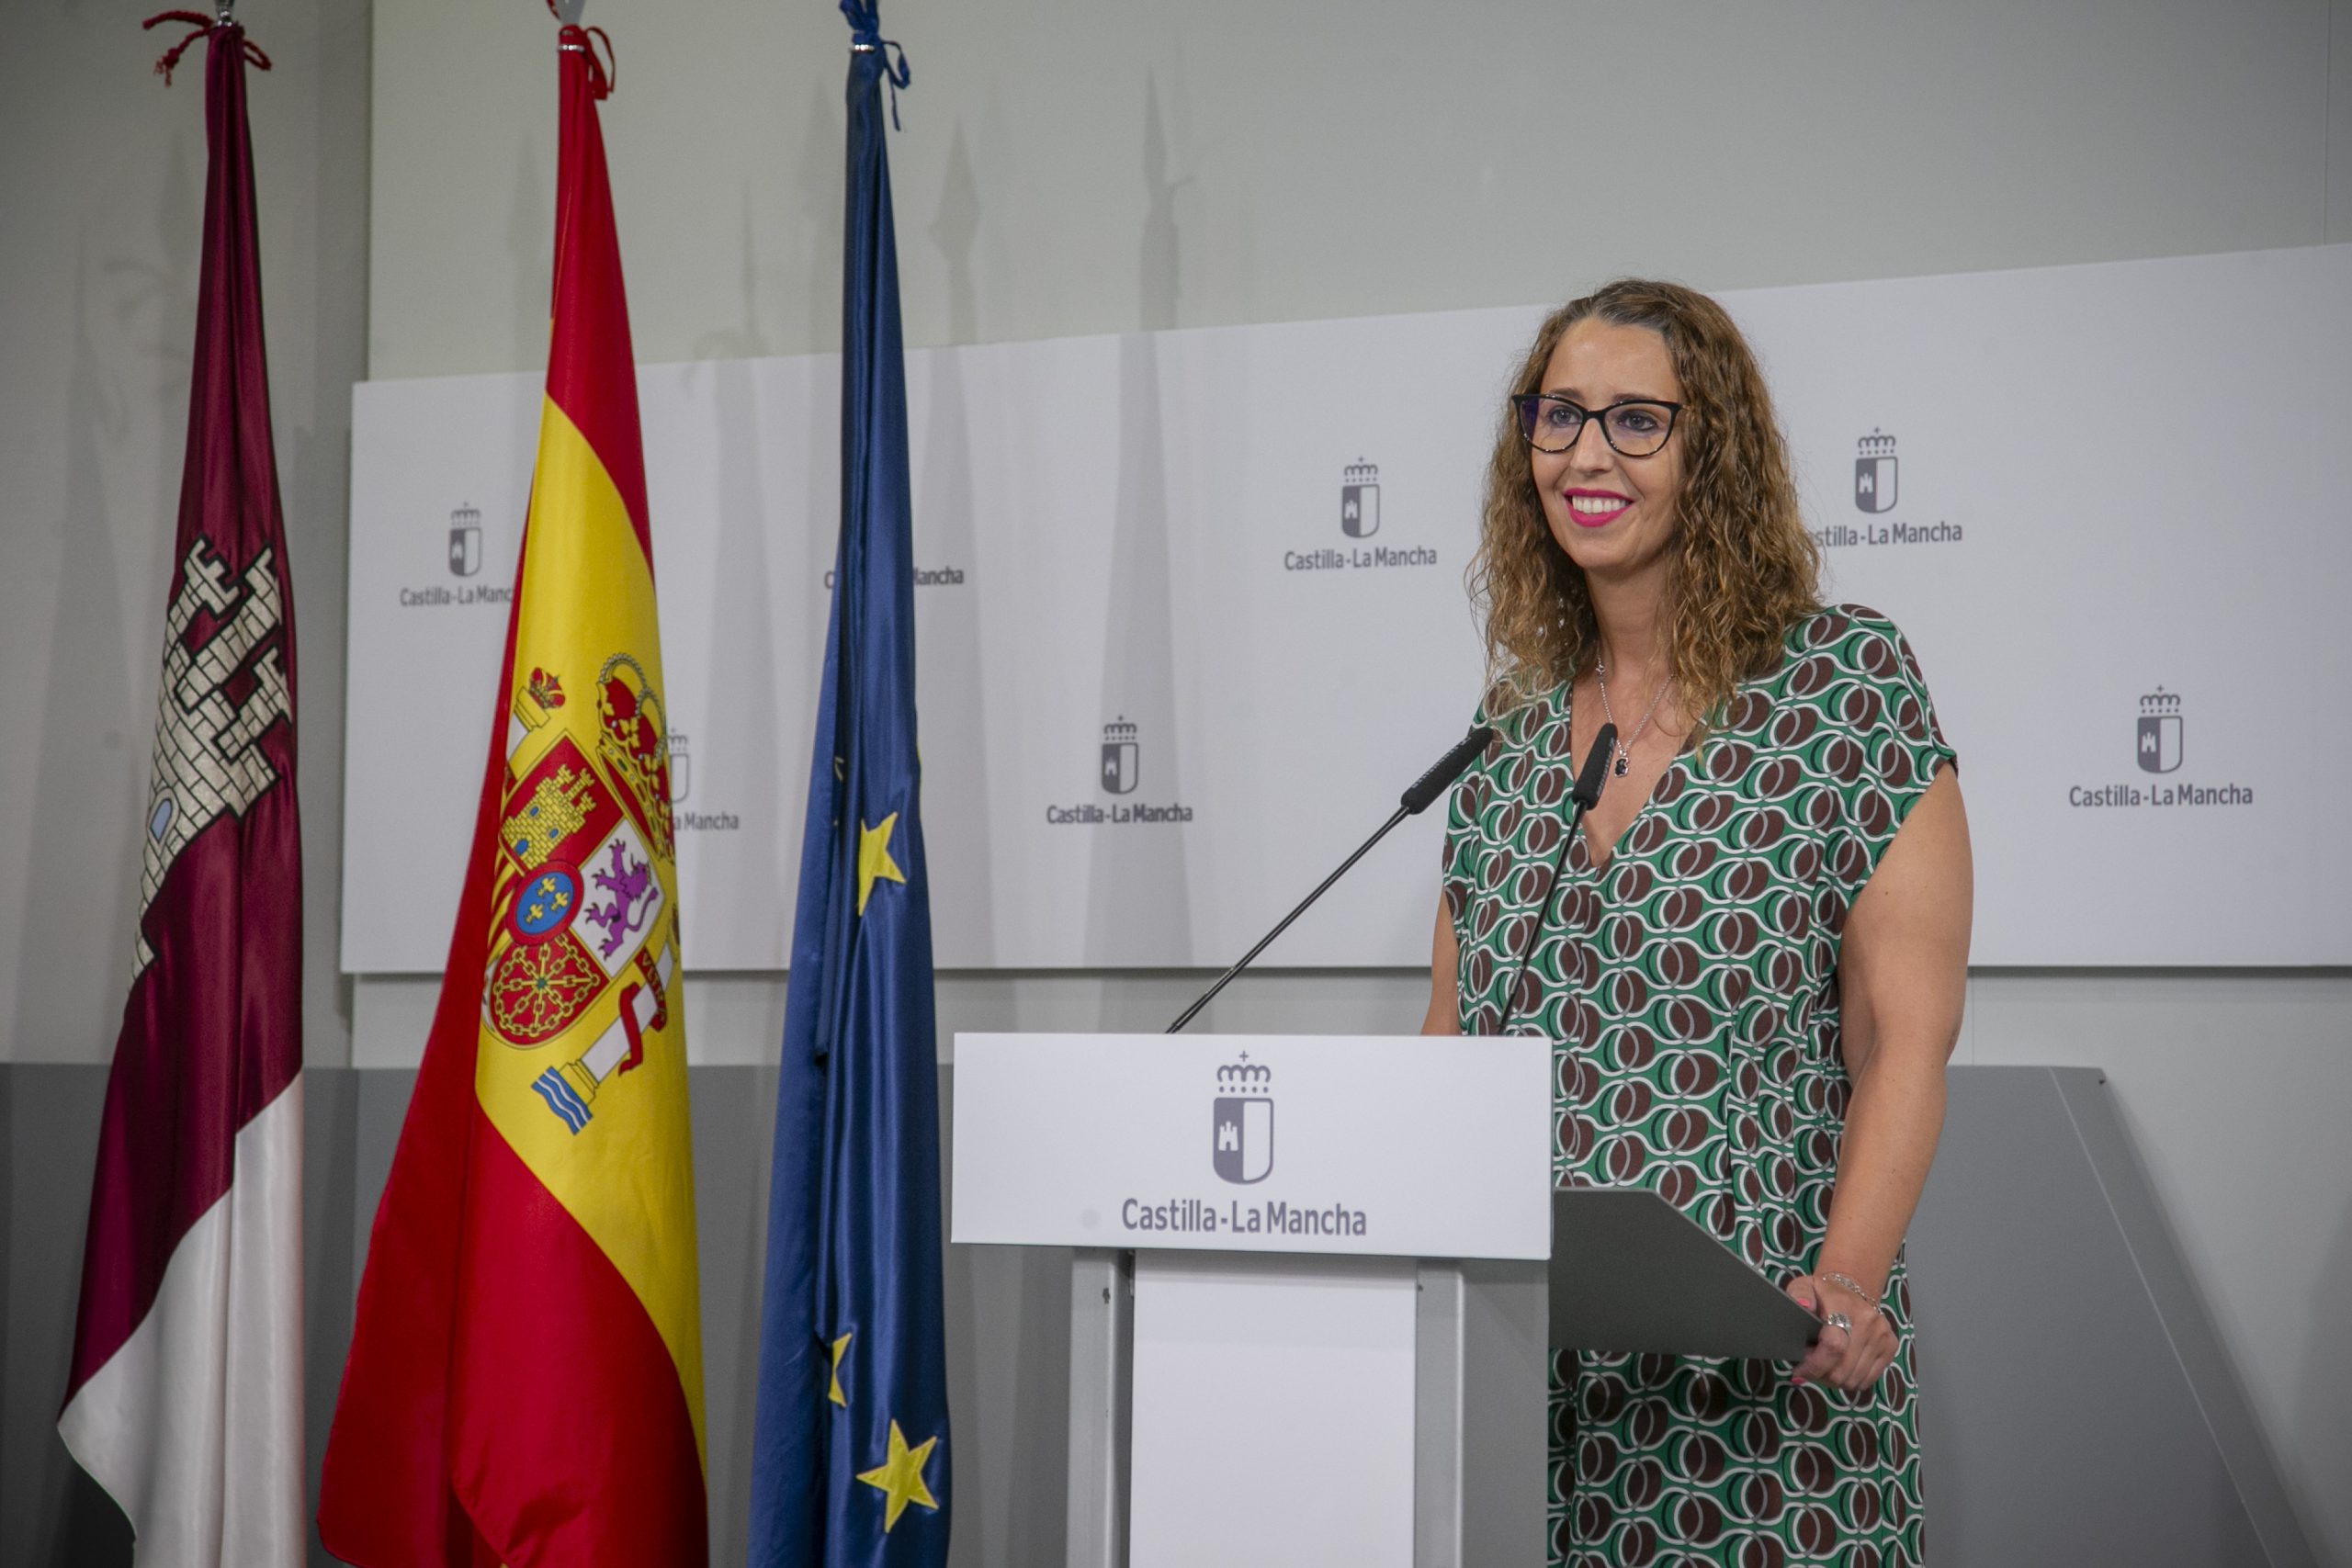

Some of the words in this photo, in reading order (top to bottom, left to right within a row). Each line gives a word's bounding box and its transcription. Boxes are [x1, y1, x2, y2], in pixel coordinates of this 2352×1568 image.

[1893, 521, 1963, 544] Mancha
[1375, 546, 1437, 568] Mancha
[477, 584, 514, 604] Manc
[2177, 783, 2254, 806] Mancha
[684, 811, 740, 831] Mancha
[1133, 802, 1193, 823] Mancha
[1267, 1201, 1368, 1236] Mancha
